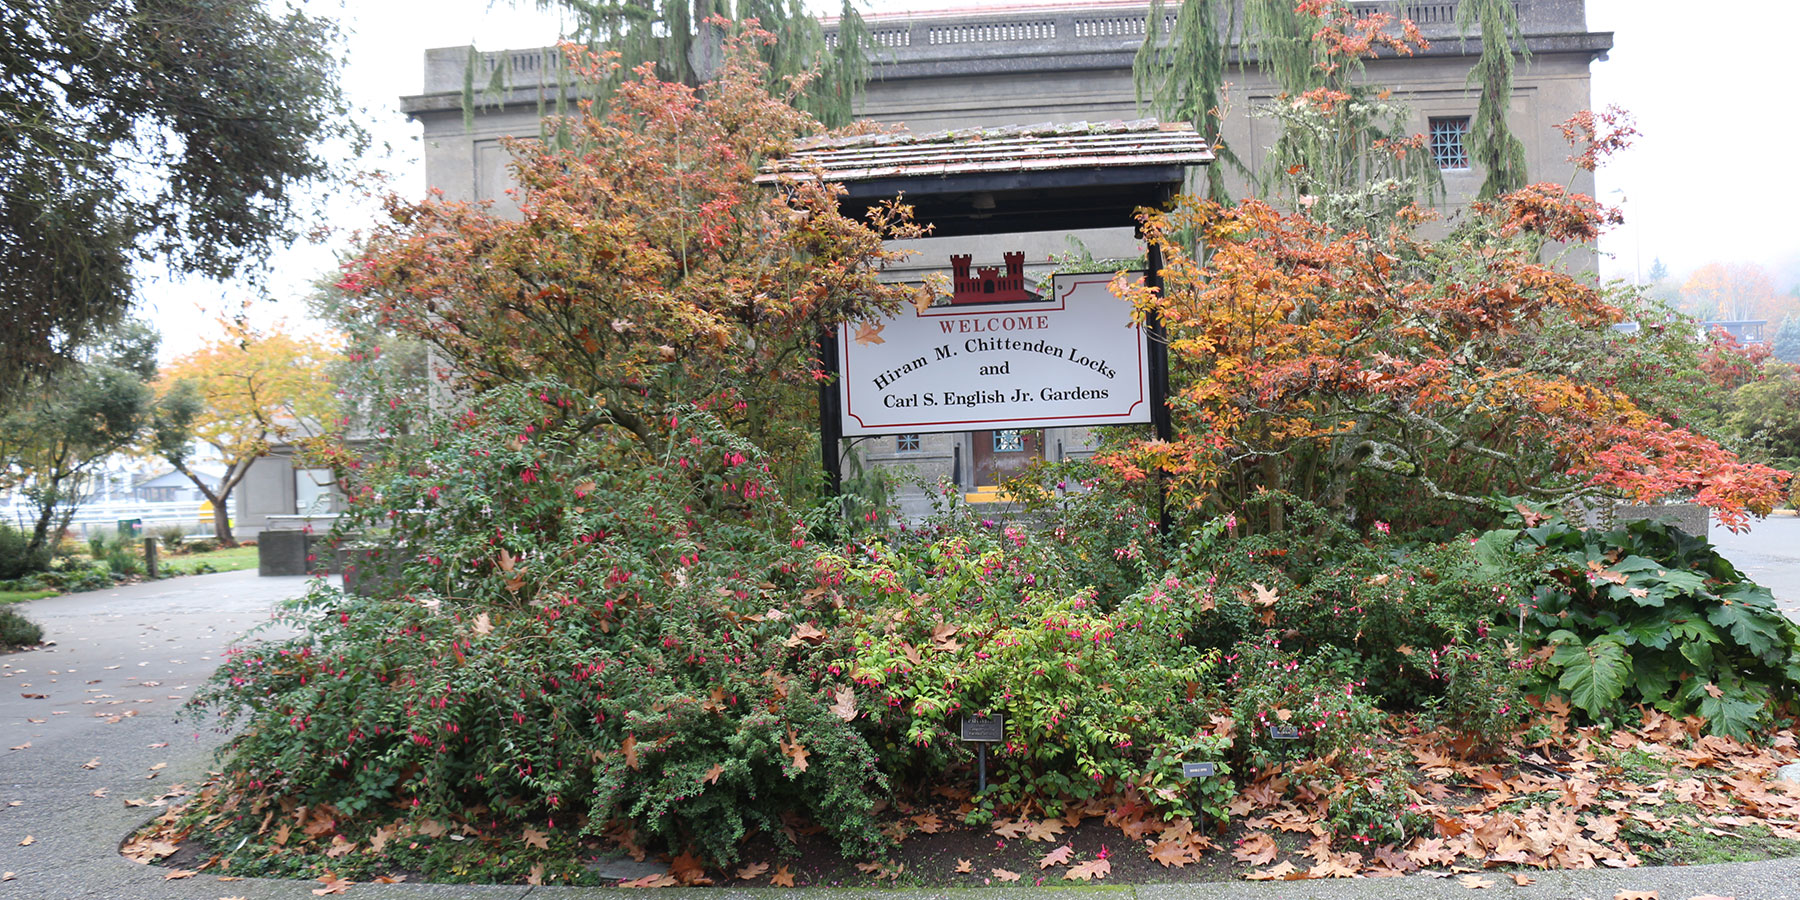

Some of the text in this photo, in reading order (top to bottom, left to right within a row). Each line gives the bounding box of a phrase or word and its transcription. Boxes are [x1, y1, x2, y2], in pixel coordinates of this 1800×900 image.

[939, 315, 1049, 334] WELCOME
[872, 337, 1116, 391] Hiram M. Chittenden Locks
[979, 361, 1010, 376] and
[883, 386, 1109, 408] Carl S. English Jr. Gardens
